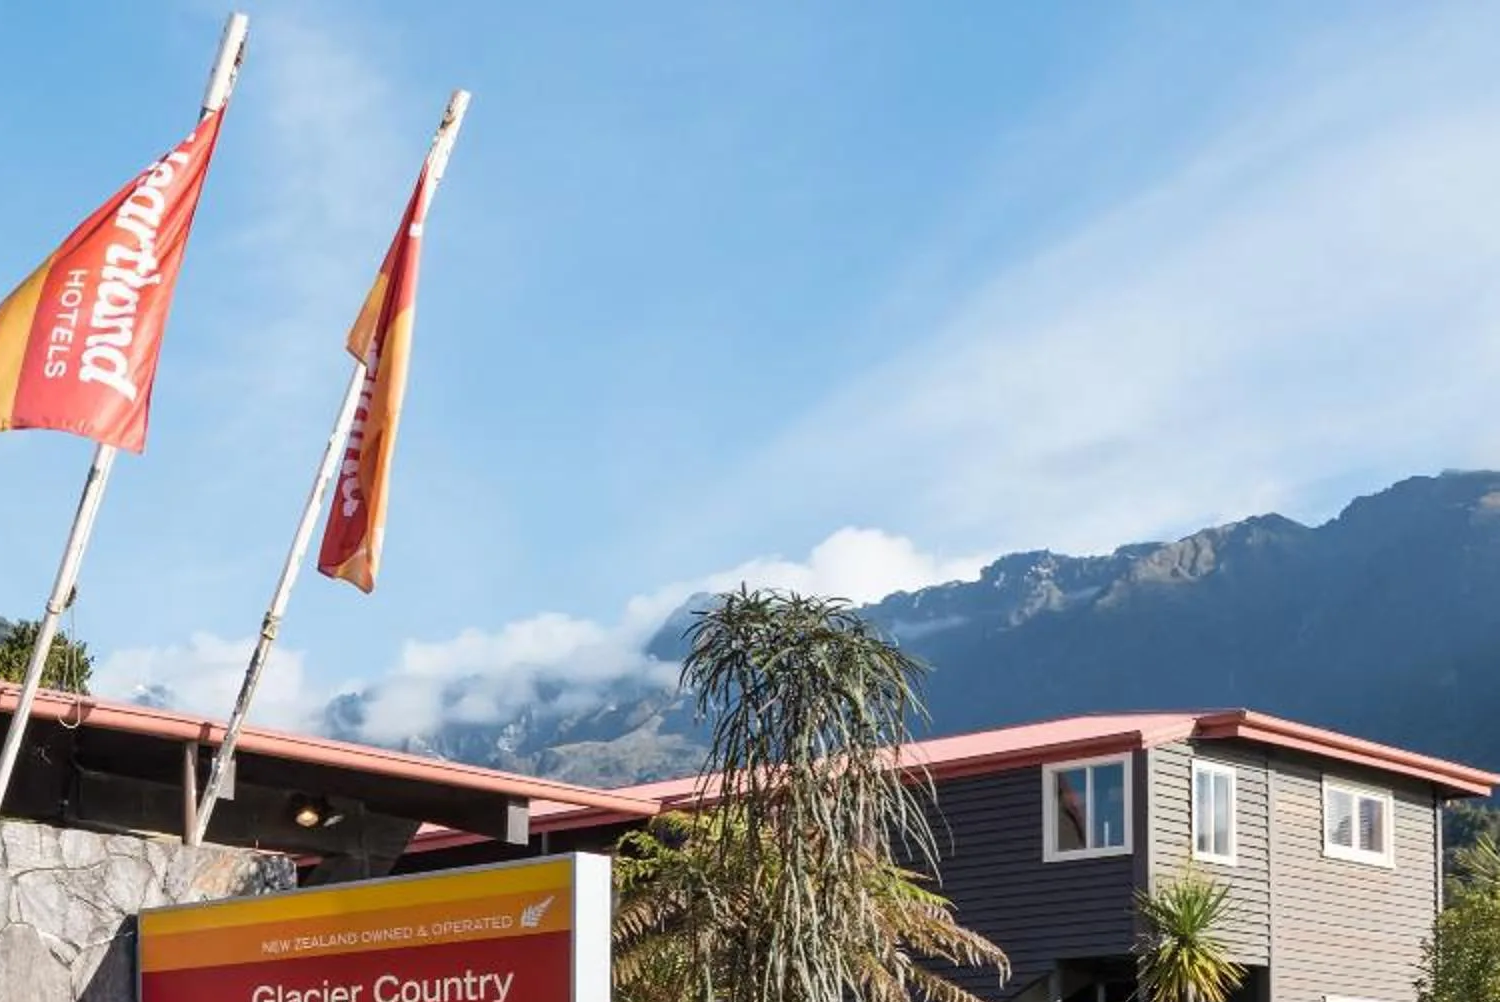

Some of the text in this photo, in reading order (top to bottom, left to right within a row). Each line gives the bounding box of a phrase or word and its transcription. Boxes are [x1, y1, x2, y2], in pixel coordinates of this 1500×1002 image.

[44, 268, 89, 378] HOTELS
[261, 915, 513, 955] NEW ZEALAND OWNED & OPERATED
